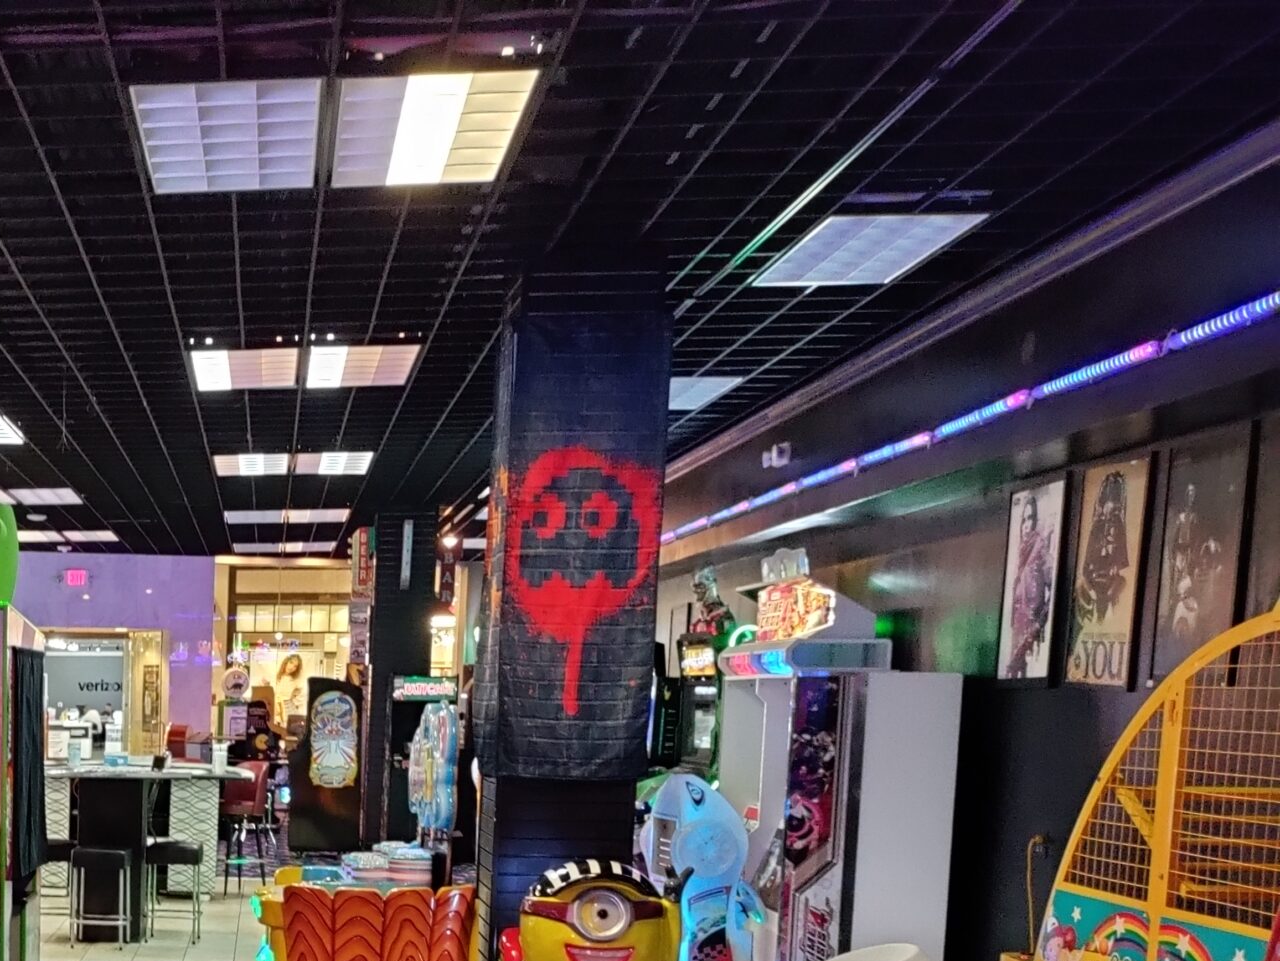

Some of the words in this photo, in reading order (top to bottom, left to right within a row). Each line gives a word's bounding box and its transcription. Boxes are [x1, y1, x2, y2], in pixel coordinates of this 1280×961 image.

[359, 530, 368, 580] BEER
[442, 552, 453, 600] BAR
[1081, 640, 1127, 680] YOU
[78, 678, 123, 692] verizo
